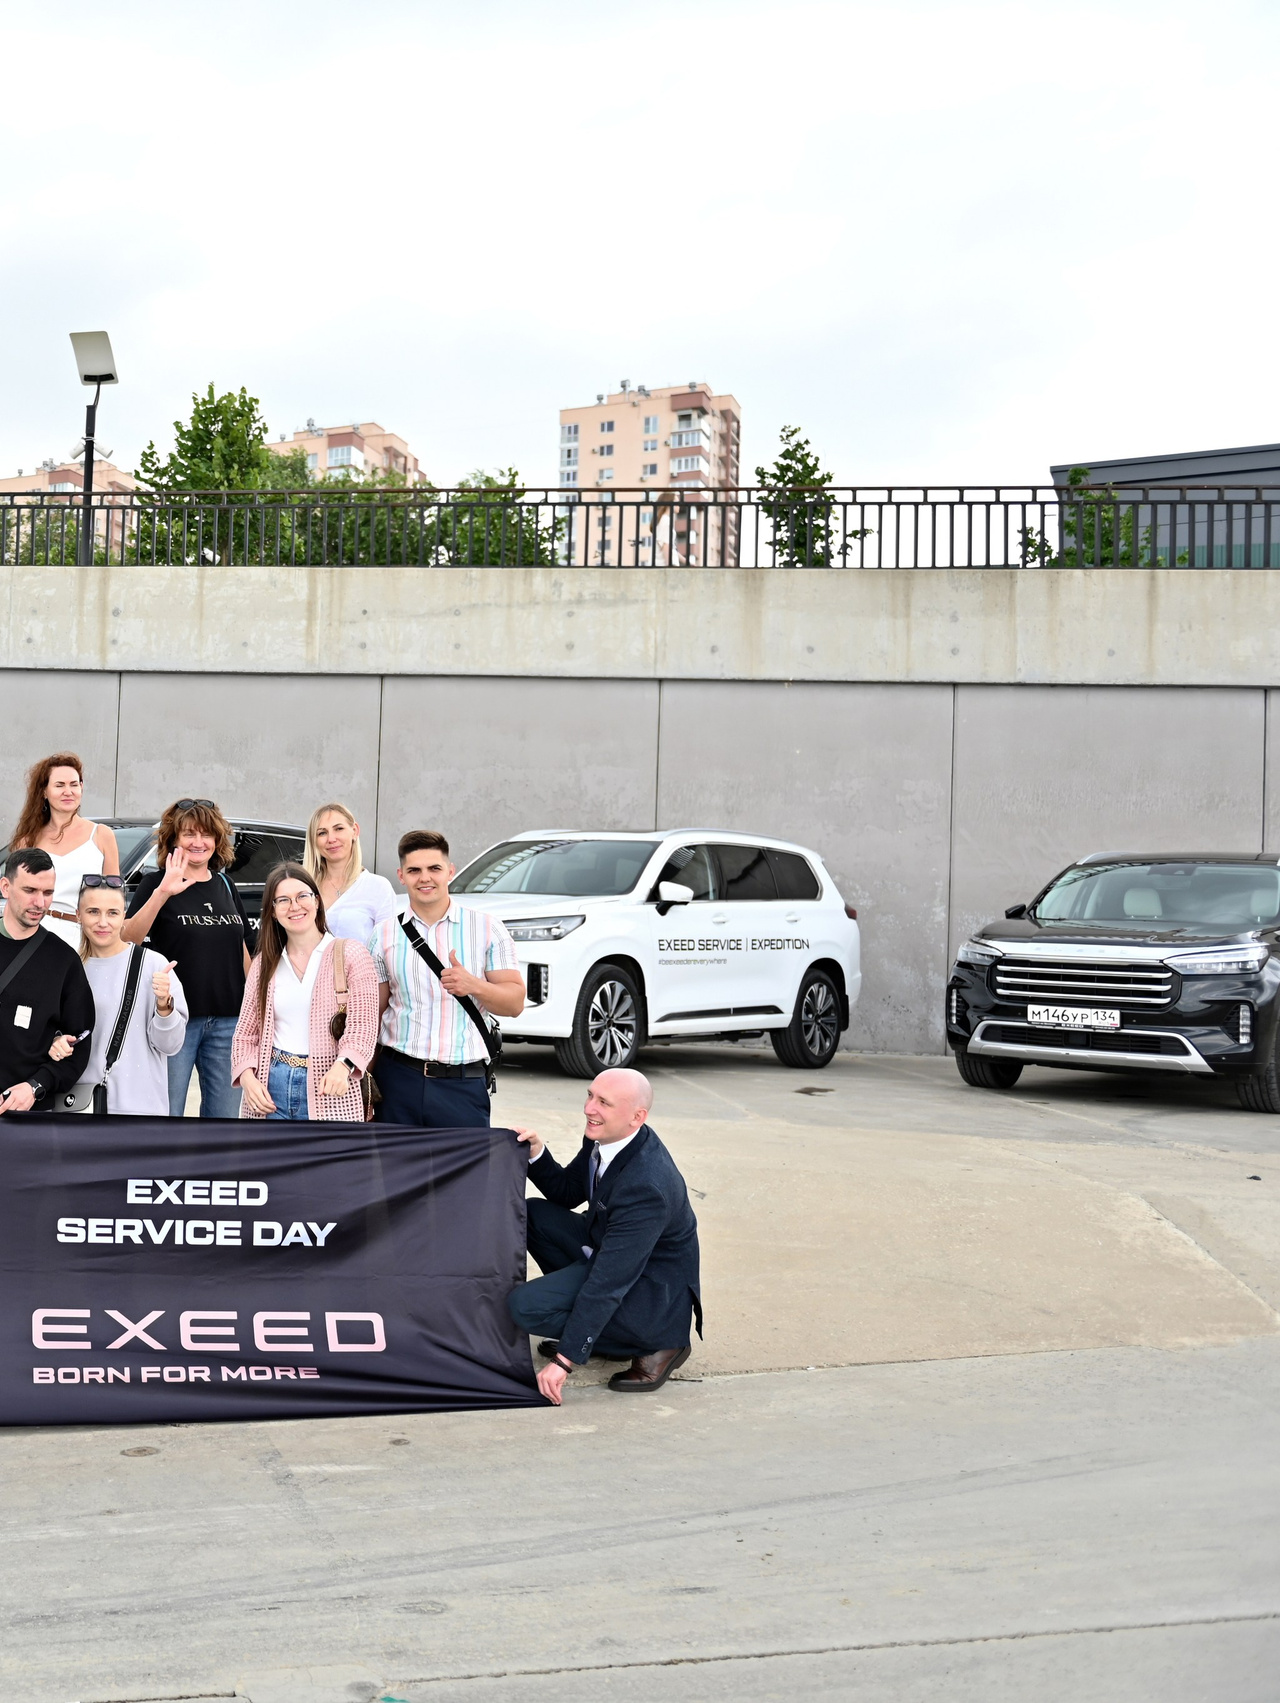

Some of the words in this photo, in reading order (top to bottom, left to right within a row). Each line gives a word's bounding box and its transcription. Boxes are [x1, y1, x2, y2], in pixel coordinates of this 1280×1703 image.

[177, 914, 244, 926] TRUSSARD
[658, 938, 696, 951] EXEED
[698, 938, 743, 951] SERVICE
[751, 938, 810, 950] EXPEDITION
[113, 1024, 125, 1047] MARC
[122, 989, 134, 1022] JACOBS
[1093, 1011, 1116, 1021] 134
[126, 1179, 268, 1206] EXEED
[56, 1218, 242, 1246] SERVICE
[253, 1221, 337, 1247] DAY
[32, 1308, 386, 1352] EXEED
[33, 1367, 130, 1384] BORN
[141, 1366, 211, 1383] FOR
[221, 1366, 320, 1382] MORE
